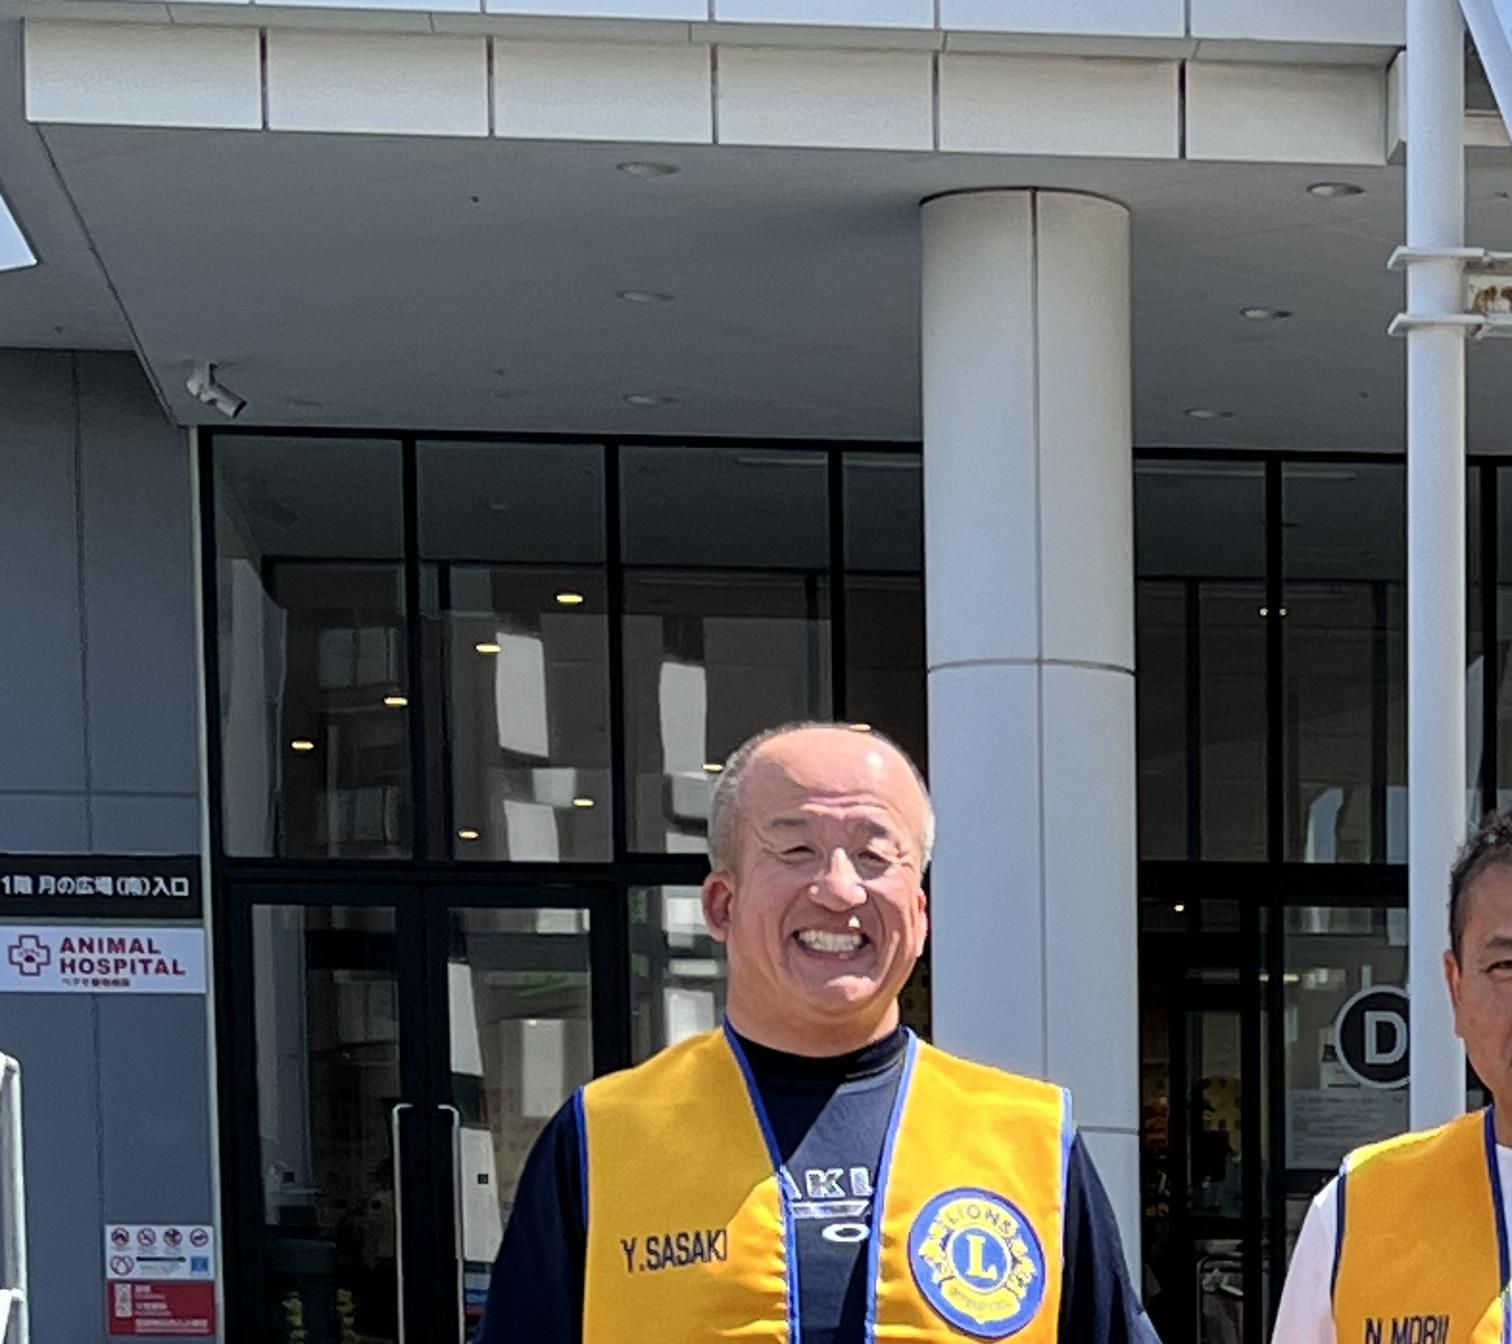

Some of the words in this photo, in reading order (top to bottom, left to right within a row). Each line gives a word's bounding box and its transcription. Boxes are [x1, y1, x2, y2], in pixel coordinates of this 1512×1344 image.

[60, 937, 161, 955] ANIMAL
[60, 959, 186, 976] HOSPITAL
[1364, 1010, 1407, 1065] D
[945, 1203, 1012, 1234] LIONS
[620, 1229, 727, 1274] Y.SASAKI
[965, 1233, 998, 1281] L
